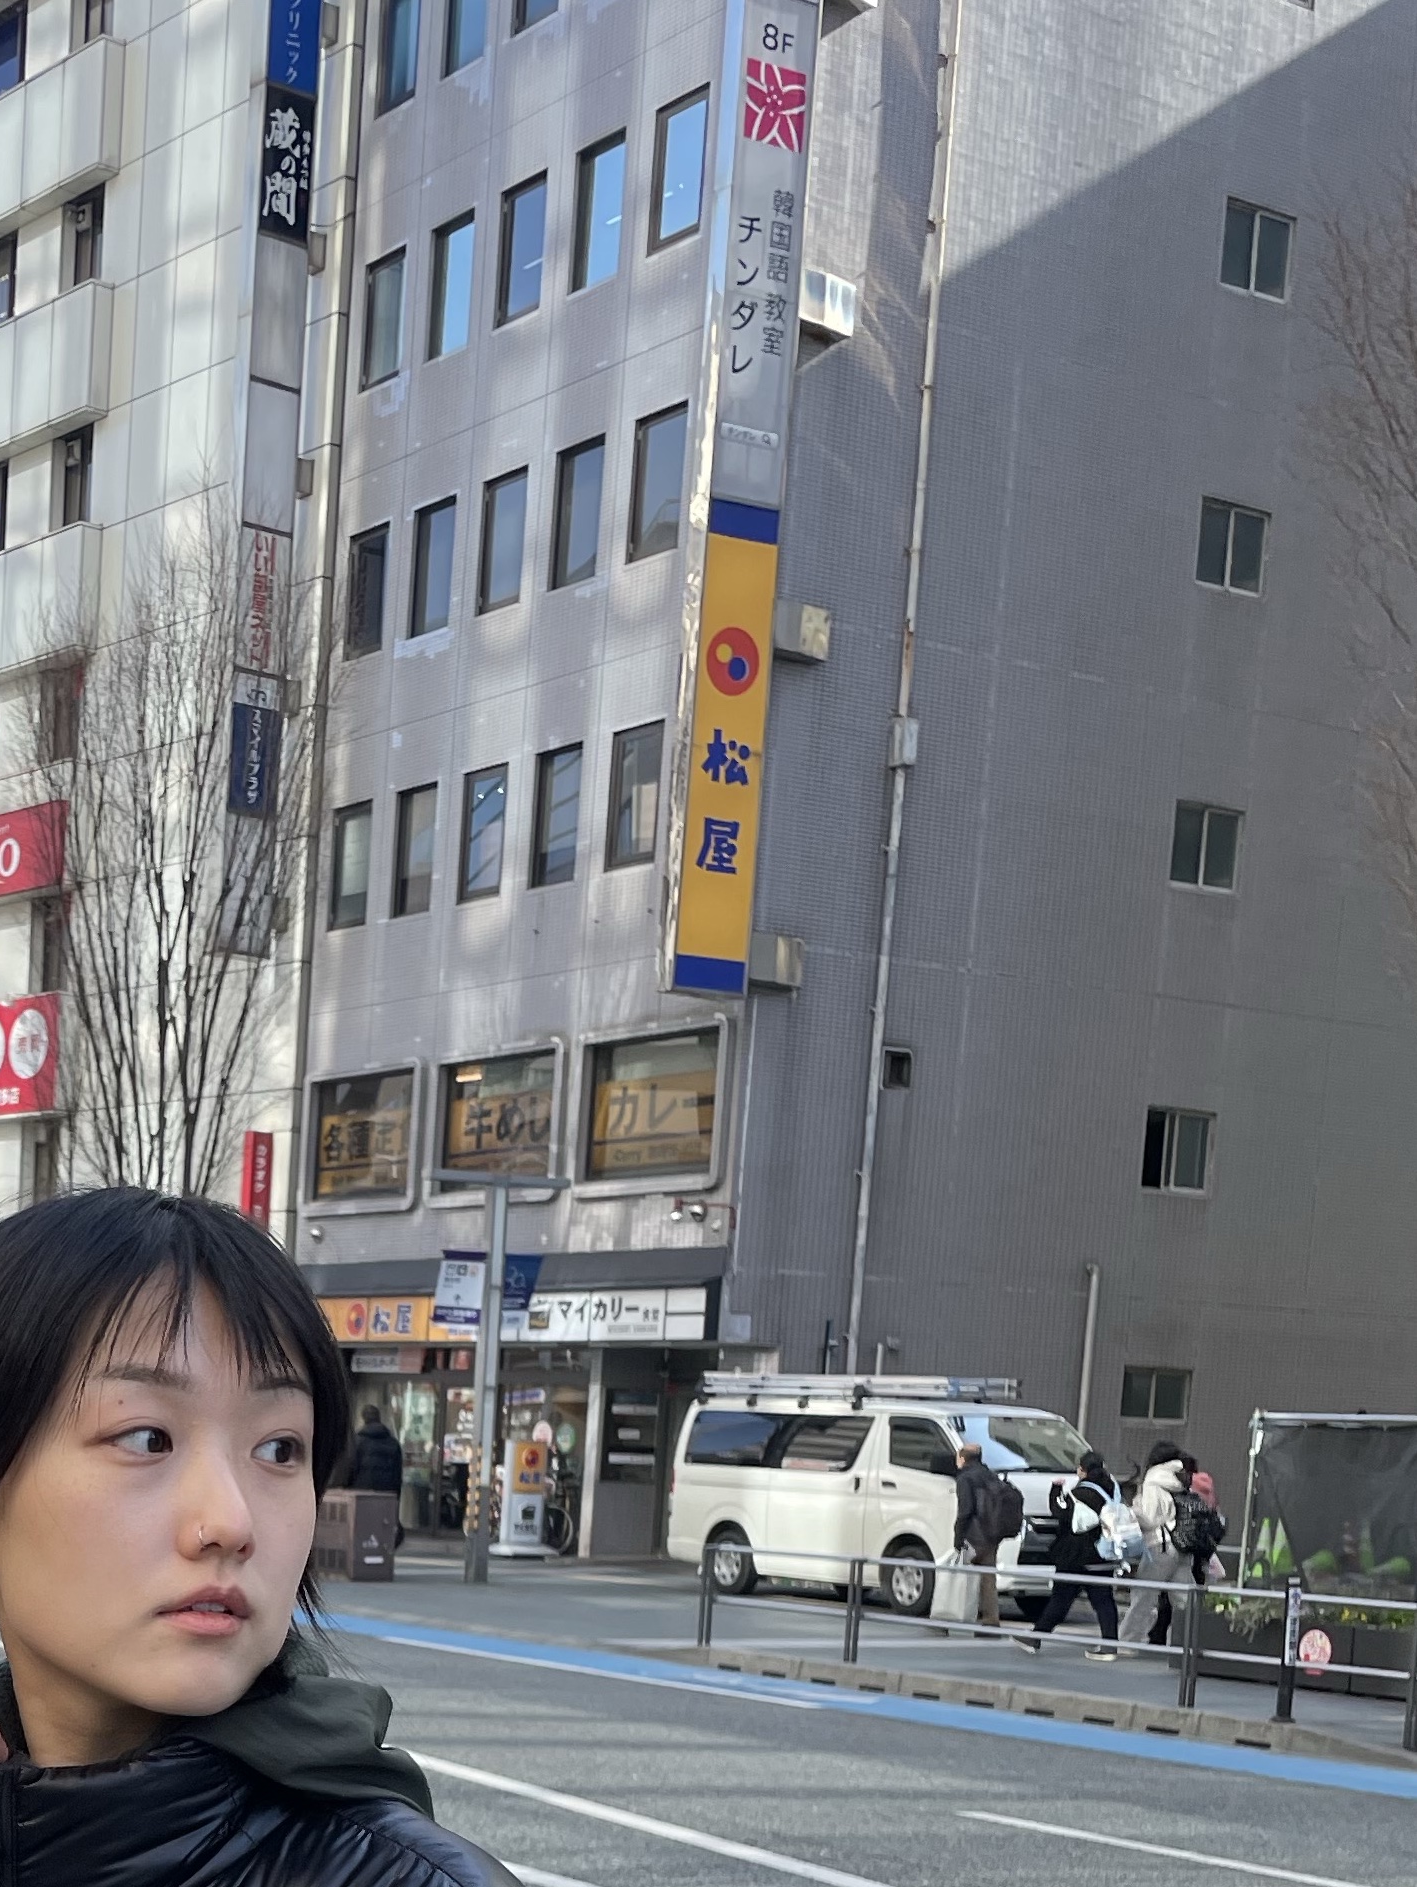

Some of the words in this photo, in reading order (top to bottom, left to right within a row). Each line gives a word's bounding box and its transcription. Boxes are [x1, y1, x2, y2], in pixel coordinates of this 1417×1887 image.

[763, 23, 795, 54] 8F
[732, 215, 763, 374] チンダレ
[695, 727, 751, 876] 松屋
